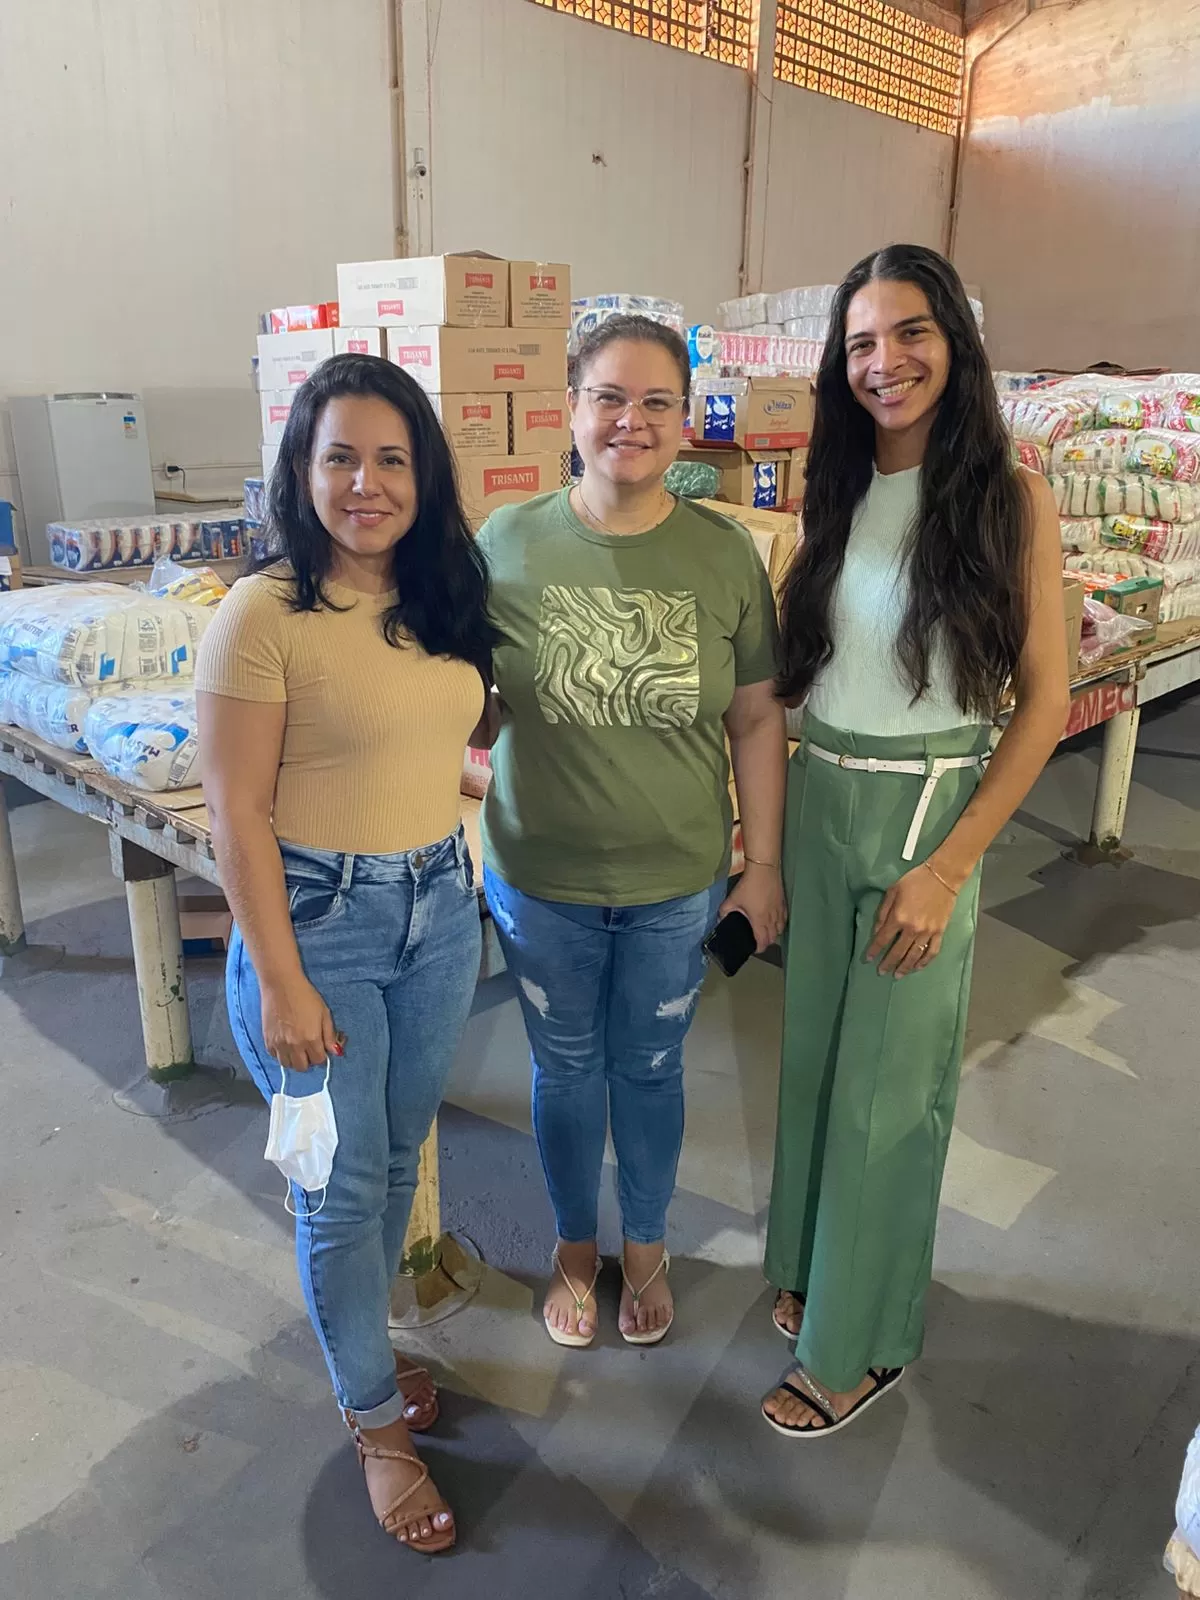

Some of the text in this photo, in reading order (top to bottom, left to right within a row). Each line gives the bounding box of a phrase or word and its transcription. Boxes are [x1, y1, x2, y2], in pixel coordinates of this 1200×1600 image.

[403, 350, 428, 361] TRISANTI
[497, 367, 522, 375] TRISANTI
[530, 413, 560, 425] TRISANTI
[491, 472, 534, 486] TRISANTI
